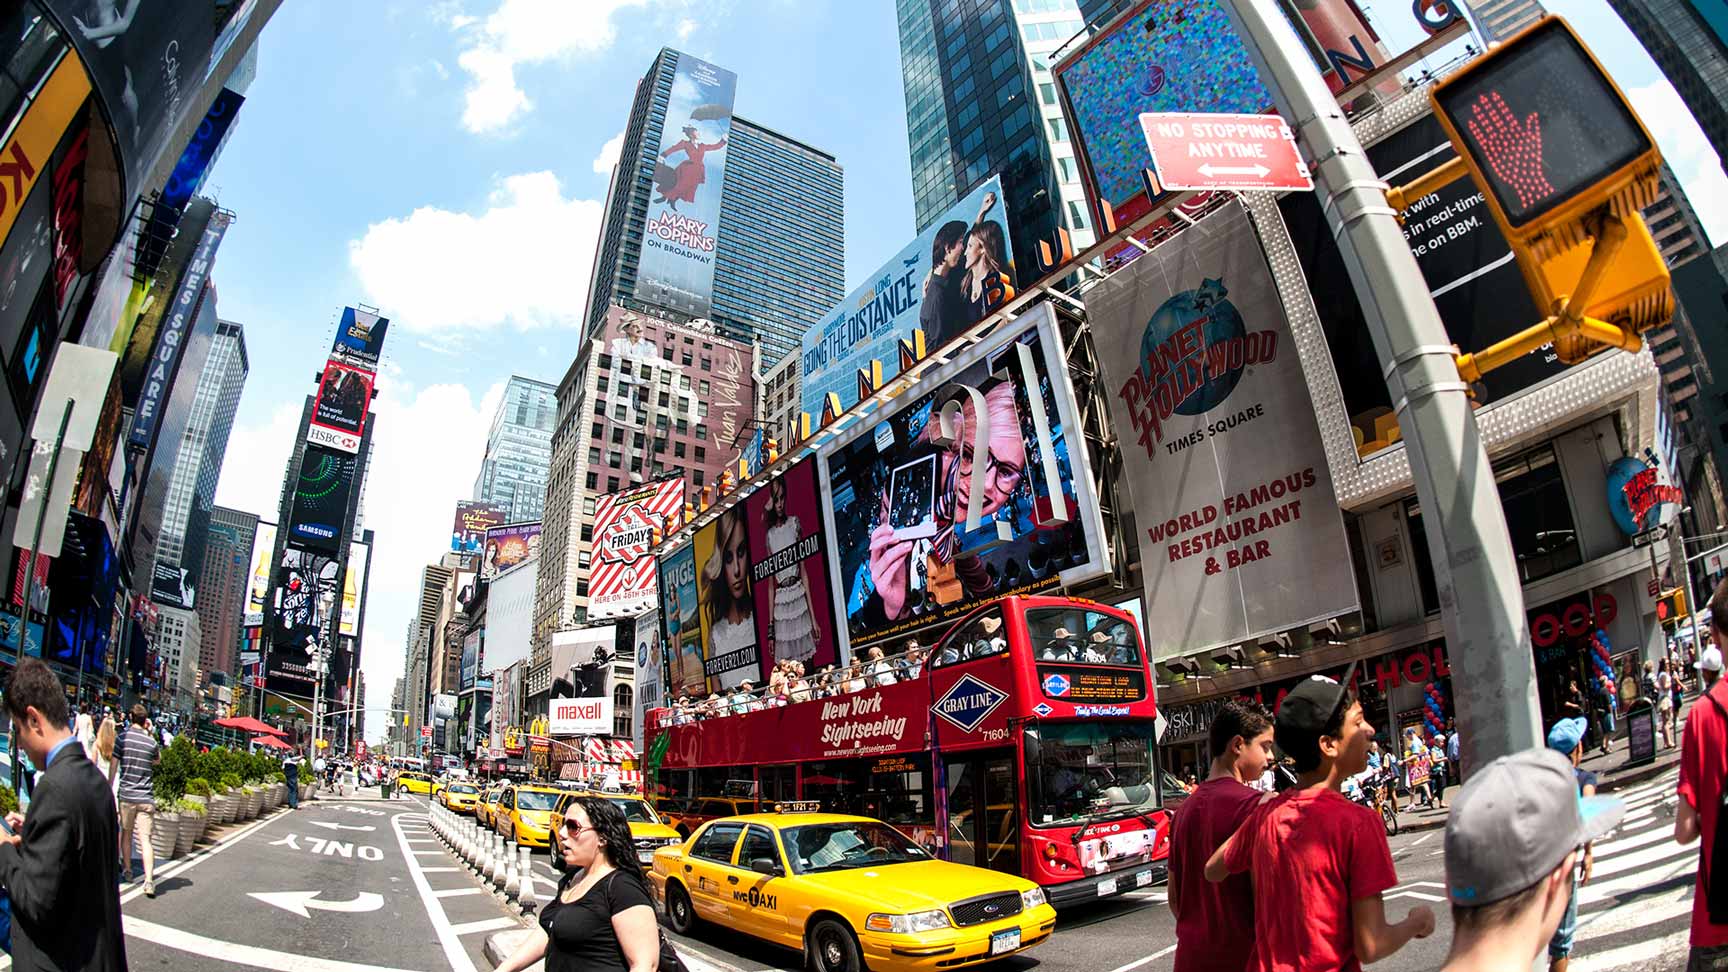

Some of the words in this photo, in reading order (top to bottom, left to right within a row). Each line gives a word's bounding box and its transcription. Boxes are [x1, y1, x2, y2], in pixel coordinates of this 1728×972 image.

[1157, 122, 1185, 139] NO
[1194, 122, 1278, 140] STOPPING
[1188, 143, 1268, 159] ANYTIME
[1410, 221, 1425, 237] in
[1427, 191, 1486, 229] real-time
[1411, 192, 1440, 214] with
[648, 217, 716, 253] POPPINS
[660, 212, 706, 235] MARY
[1429, 235, 1447, 250] on
[1449, 215, 1484, 240] BBM.
[180, 229, 220, 305] TIMES
[648, 239, 661, 251] ON
[664, 241, 711, 265] BROADWAY
[875, 273, 891, 297] LONG
[804, 339, 827, 377] GOING
[828, 323, 848, 358] THE
[848, 268, 918, 347] DISTANCE
[140, 314, 183, 418] SQUARE
[714, 343, 744, 411] Valdez
[1119, 316, 1210, 430] PLANET
[319, 403, 329, 411] The
[1137, 330, 1280, 463] HOLLYWOOD
[311, 428, 341, 445] HSBC
[712, 408, 743, 467] Juan
[1166, 432, 1204, 456] TIMES
[1208, 404, 1265, 439] SQUARE
[1148, 504, 1218, 544] WORLD
[1224, 467, 1317, 512] FAMOUS
[298, 523, 334, 538] SAMSUNG
[1168, 500, 1302, 564] RESTAURANT
[754, 534, 820, 582] FOREVER21.COM
[1204, 557, 1222, 577] &
[1228, 540, 1273, 569] BAR
[664, 559, 694, 594] HUGE
[594, 594, 612, 610] HERE
[612, 592, 621, 603] ON
[641, 586, 657, 598] STRE
[944, 606, 960, 617] Speak
[961, 602, 972, 611] with
[999, 585, 1032, 599] vocabulary
[705, 647, 757, 676] FOREVER21.COM
[557, 702, 602, 720] maxell
[821, 701, 850, 721] New
[851, 692, 883, 717] York
[943, 696, 970, 714] GRAY
[971, 691, 993, 711] LINE
[821, 714, 907, 748] Sightseeing
[983, 728, 1010, 742] 71604
[269, 833, 384, 861] ONLY
[733, 890, 748, 902] NYC
[748, 886, 777, 910] TAXI
